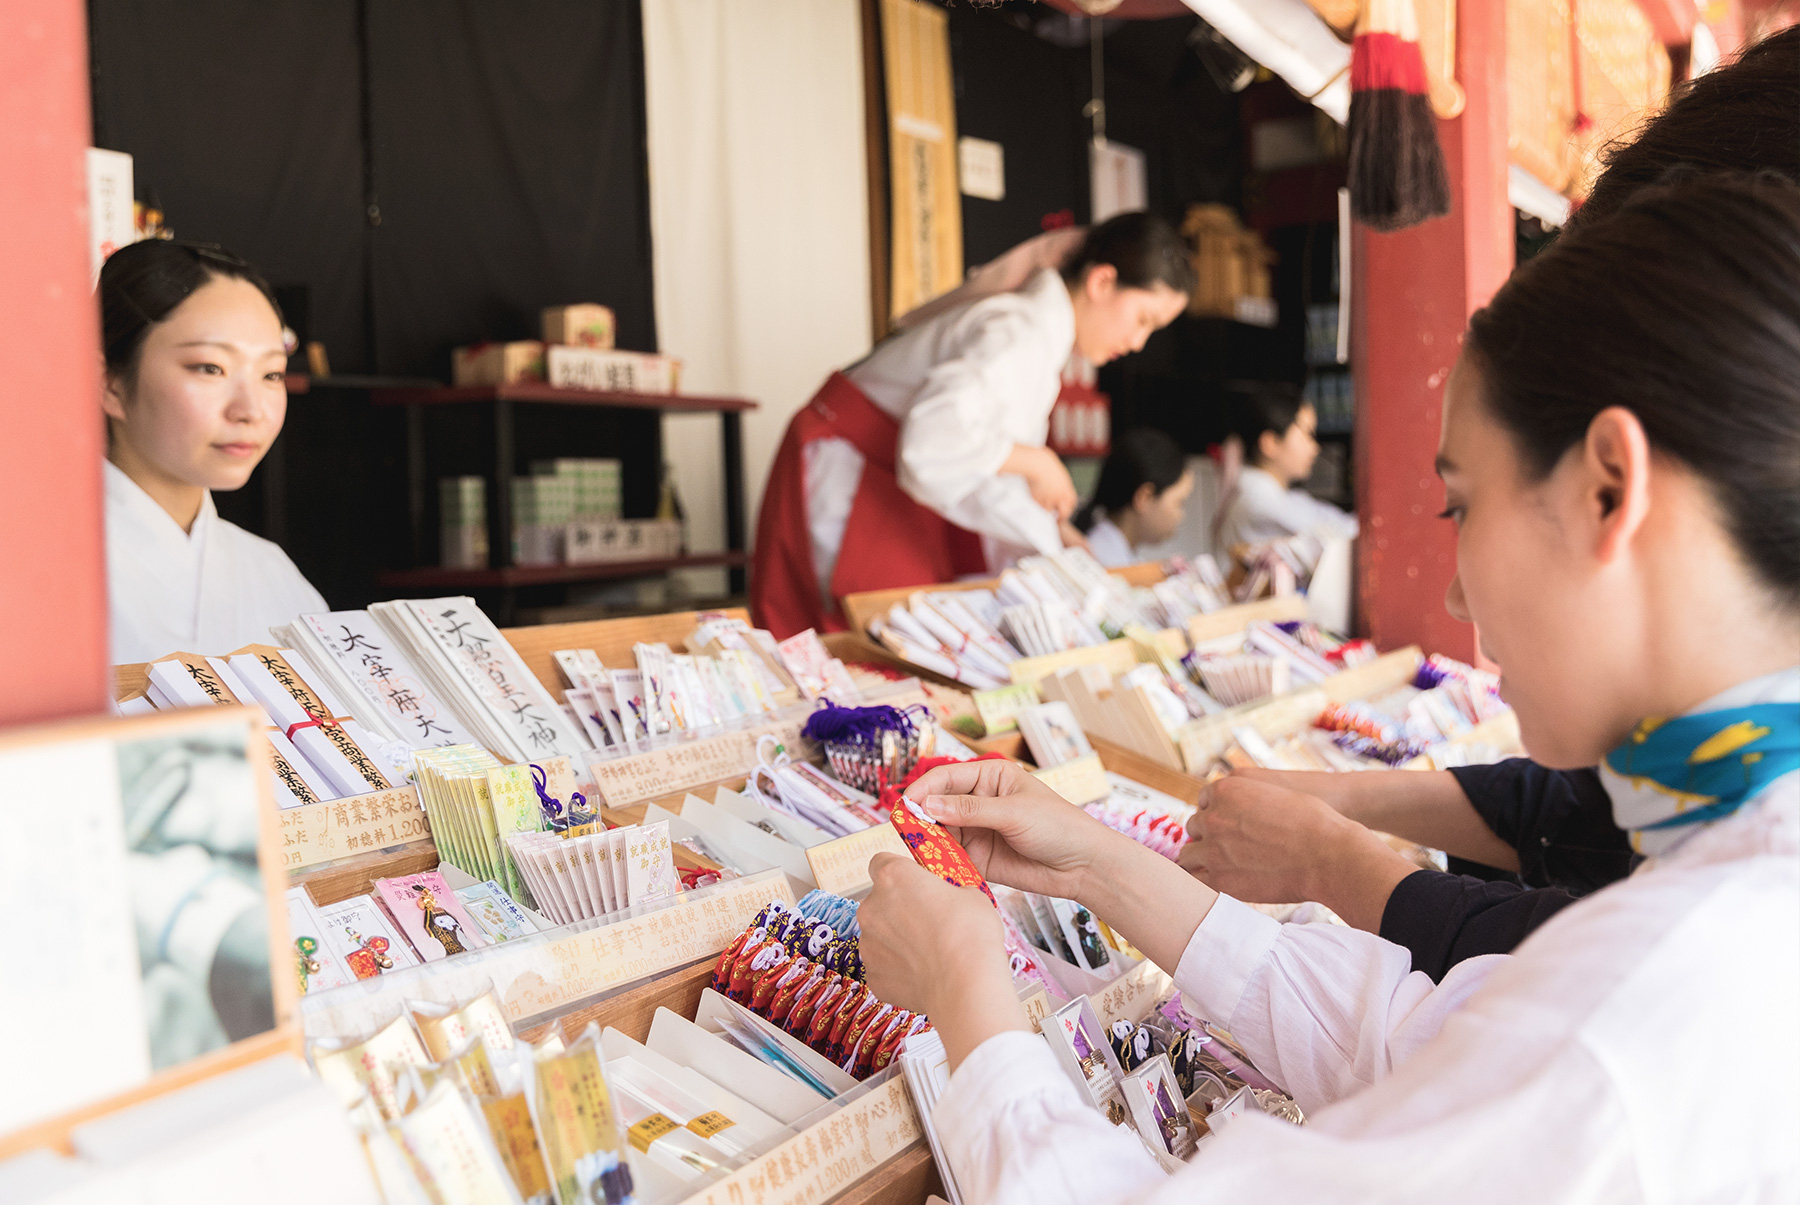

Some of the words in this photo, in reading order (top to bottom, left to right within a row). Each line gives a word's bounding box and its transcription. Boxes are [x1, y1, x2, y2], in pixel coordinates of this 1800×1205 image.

[341, 625, 457, 747] 太宰府天
[629, 836, 669, 858] 就職成就
[640, 853, 661, 871] 御守
[701, 896, 730, 917] 開運
[646, 906, 700, 934] 就職成就
[591, 922, 645, 961] 仕事守
